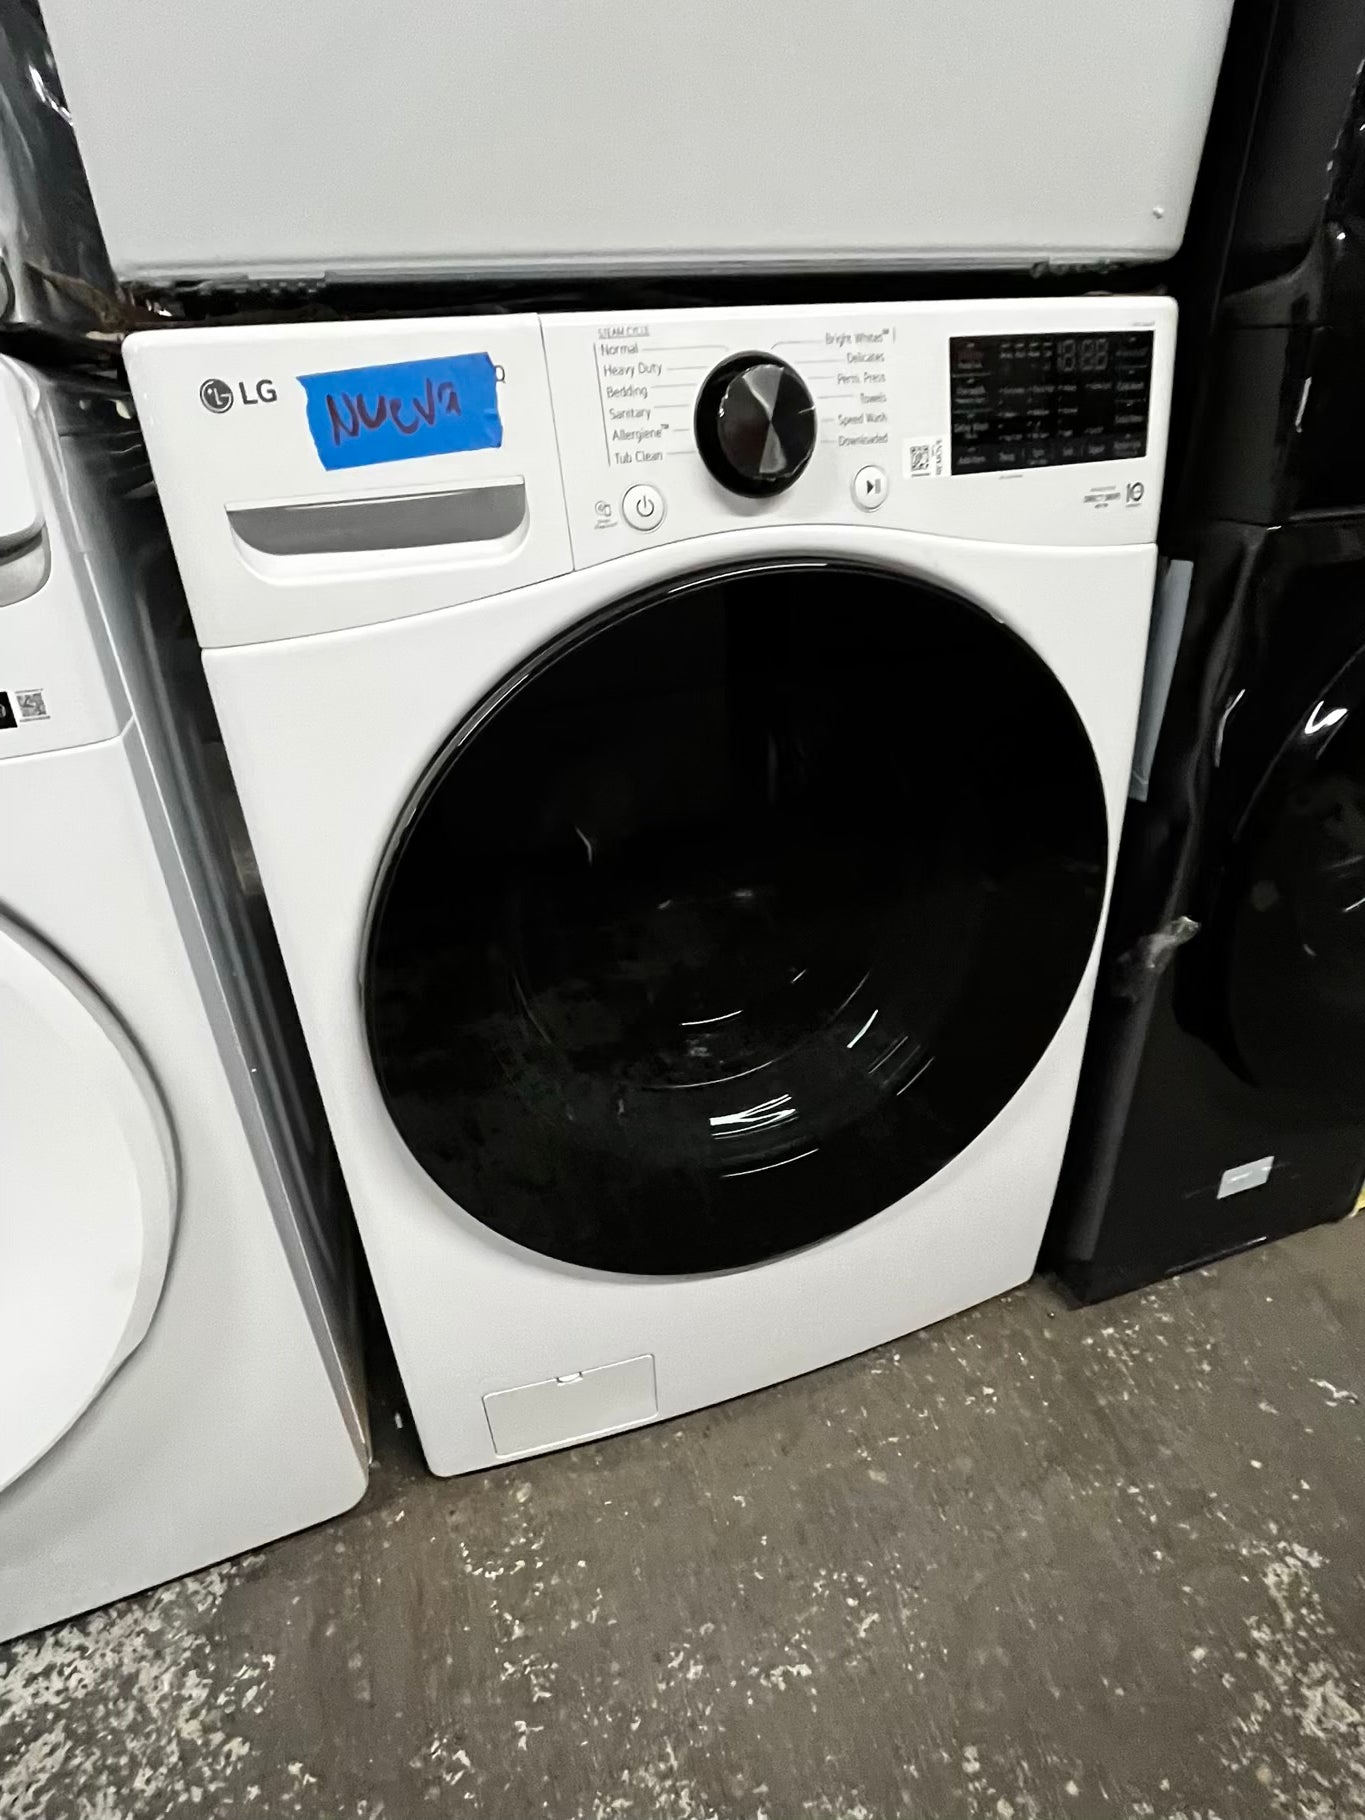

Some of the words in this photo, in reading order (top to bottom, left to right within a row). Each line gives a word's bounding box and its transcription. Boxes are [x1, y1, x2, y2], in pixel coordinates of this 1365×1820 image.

[600, 342, 639, 356] Normal
[603, 364, 635, 378] Heavy
[638, 361, 662, 376] Duty
[238, 379, 278, 405] LG
[606, 384, 648, 399] Bedding
[609, 407, 651, 421] Sanitary
[615, 452, 633, 465] Tub
[635, 450, 663, 463] Clean
